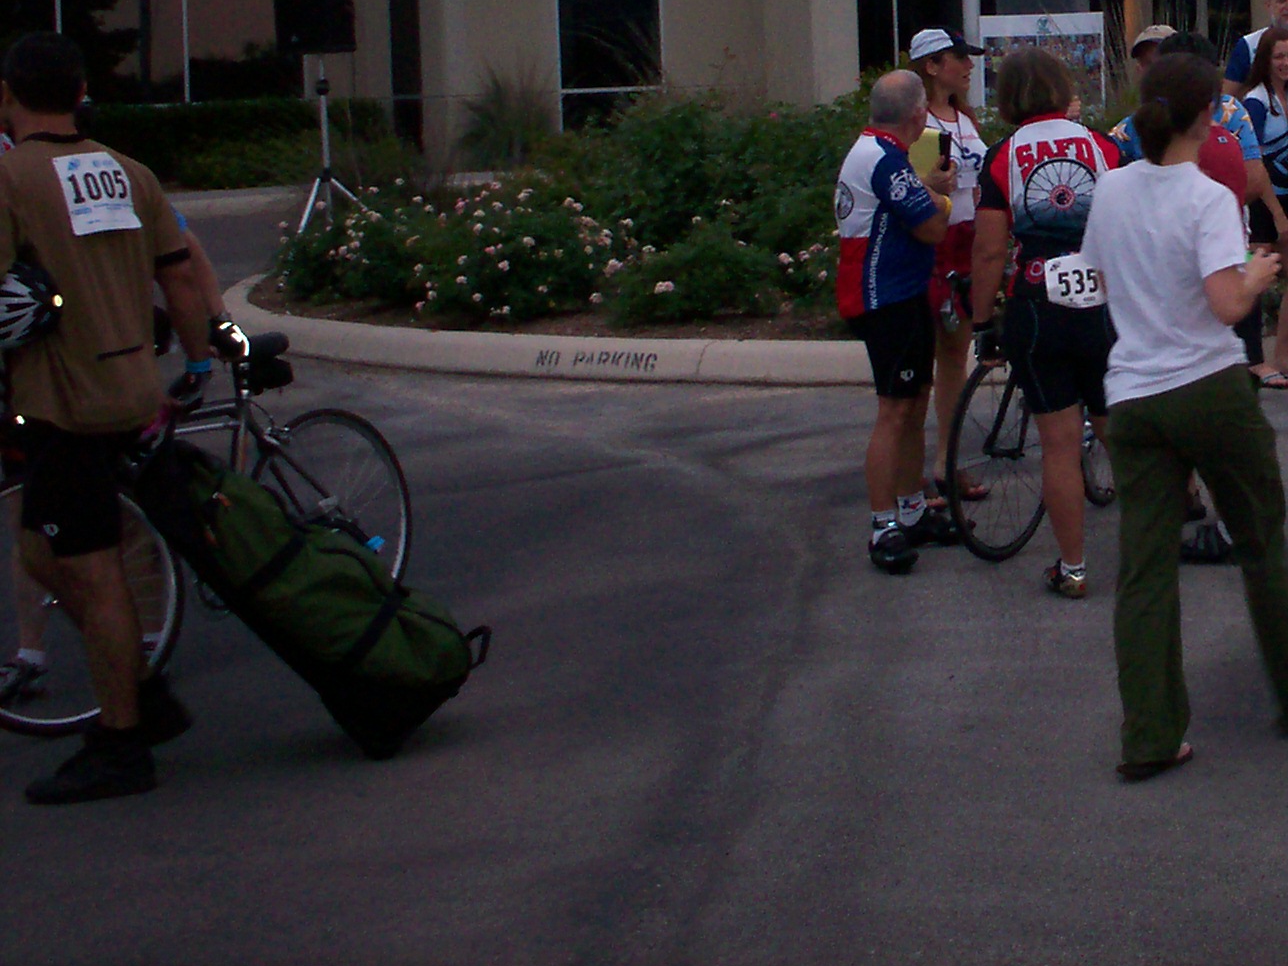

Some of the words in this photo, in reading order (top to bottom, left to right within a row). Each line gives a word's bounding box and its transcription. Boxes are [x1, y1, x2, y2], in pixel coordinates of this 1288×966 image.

[1015, 137, 1097, 184] SAFD
[67, 169, 127, 204] 1005
[1058, 268, 1098, 296] 535
[536, 349, 562, 367] NO
[573, 351, 658, 372] PARKING
